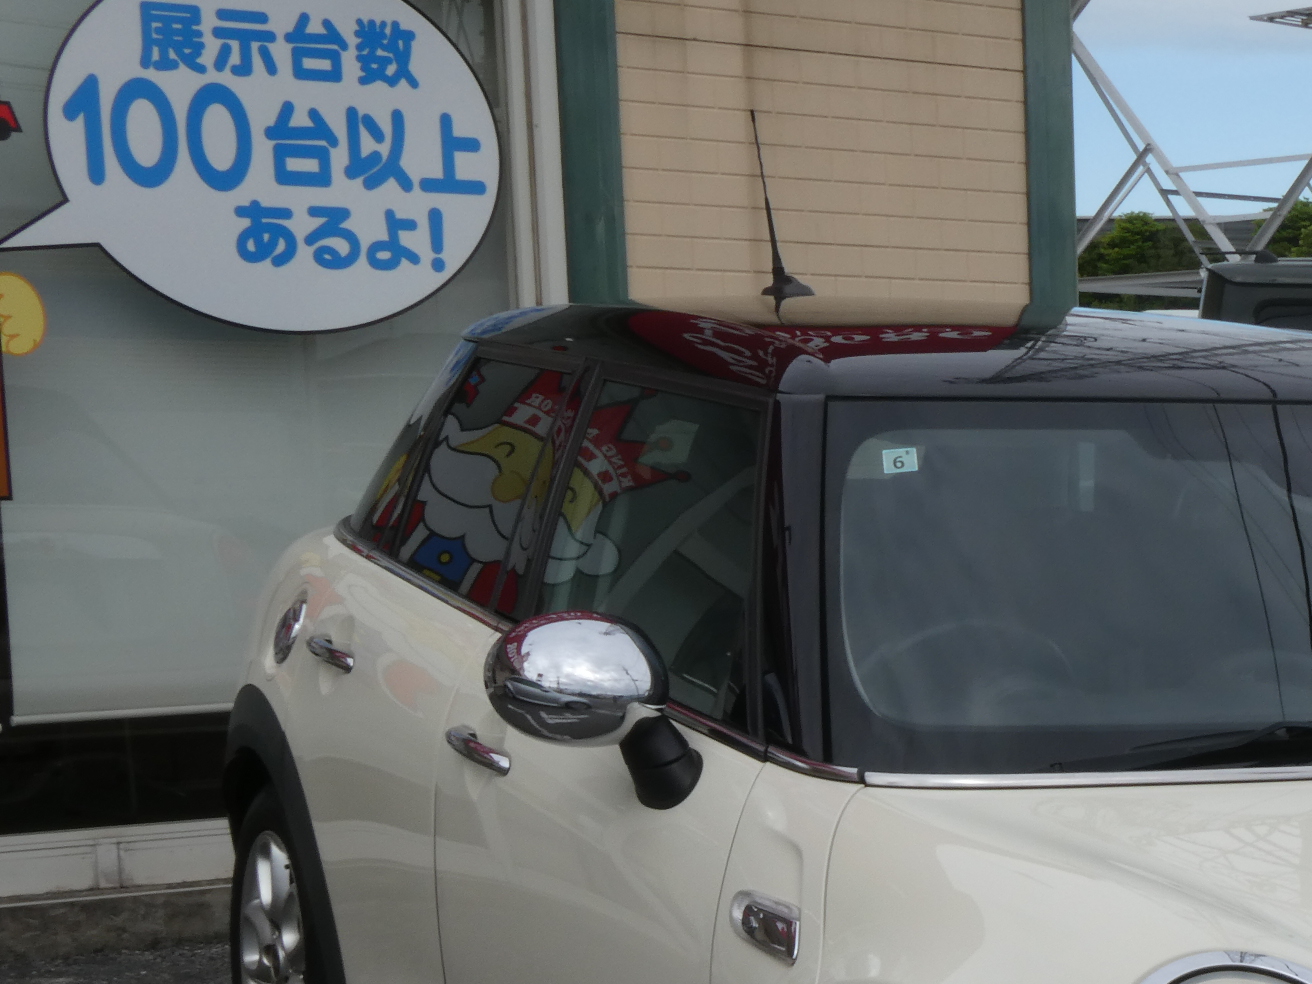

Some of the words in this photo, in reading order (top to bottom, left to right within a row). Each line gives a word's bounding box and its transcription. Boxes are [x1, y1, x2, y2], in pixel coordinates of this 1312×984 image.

[139, 1, 419, 90] 展示台数
[62, 73, 487, 193] 100台以上
[234, 200, 446, 273] あるよ!
[893, 455, 905, 469] 6
